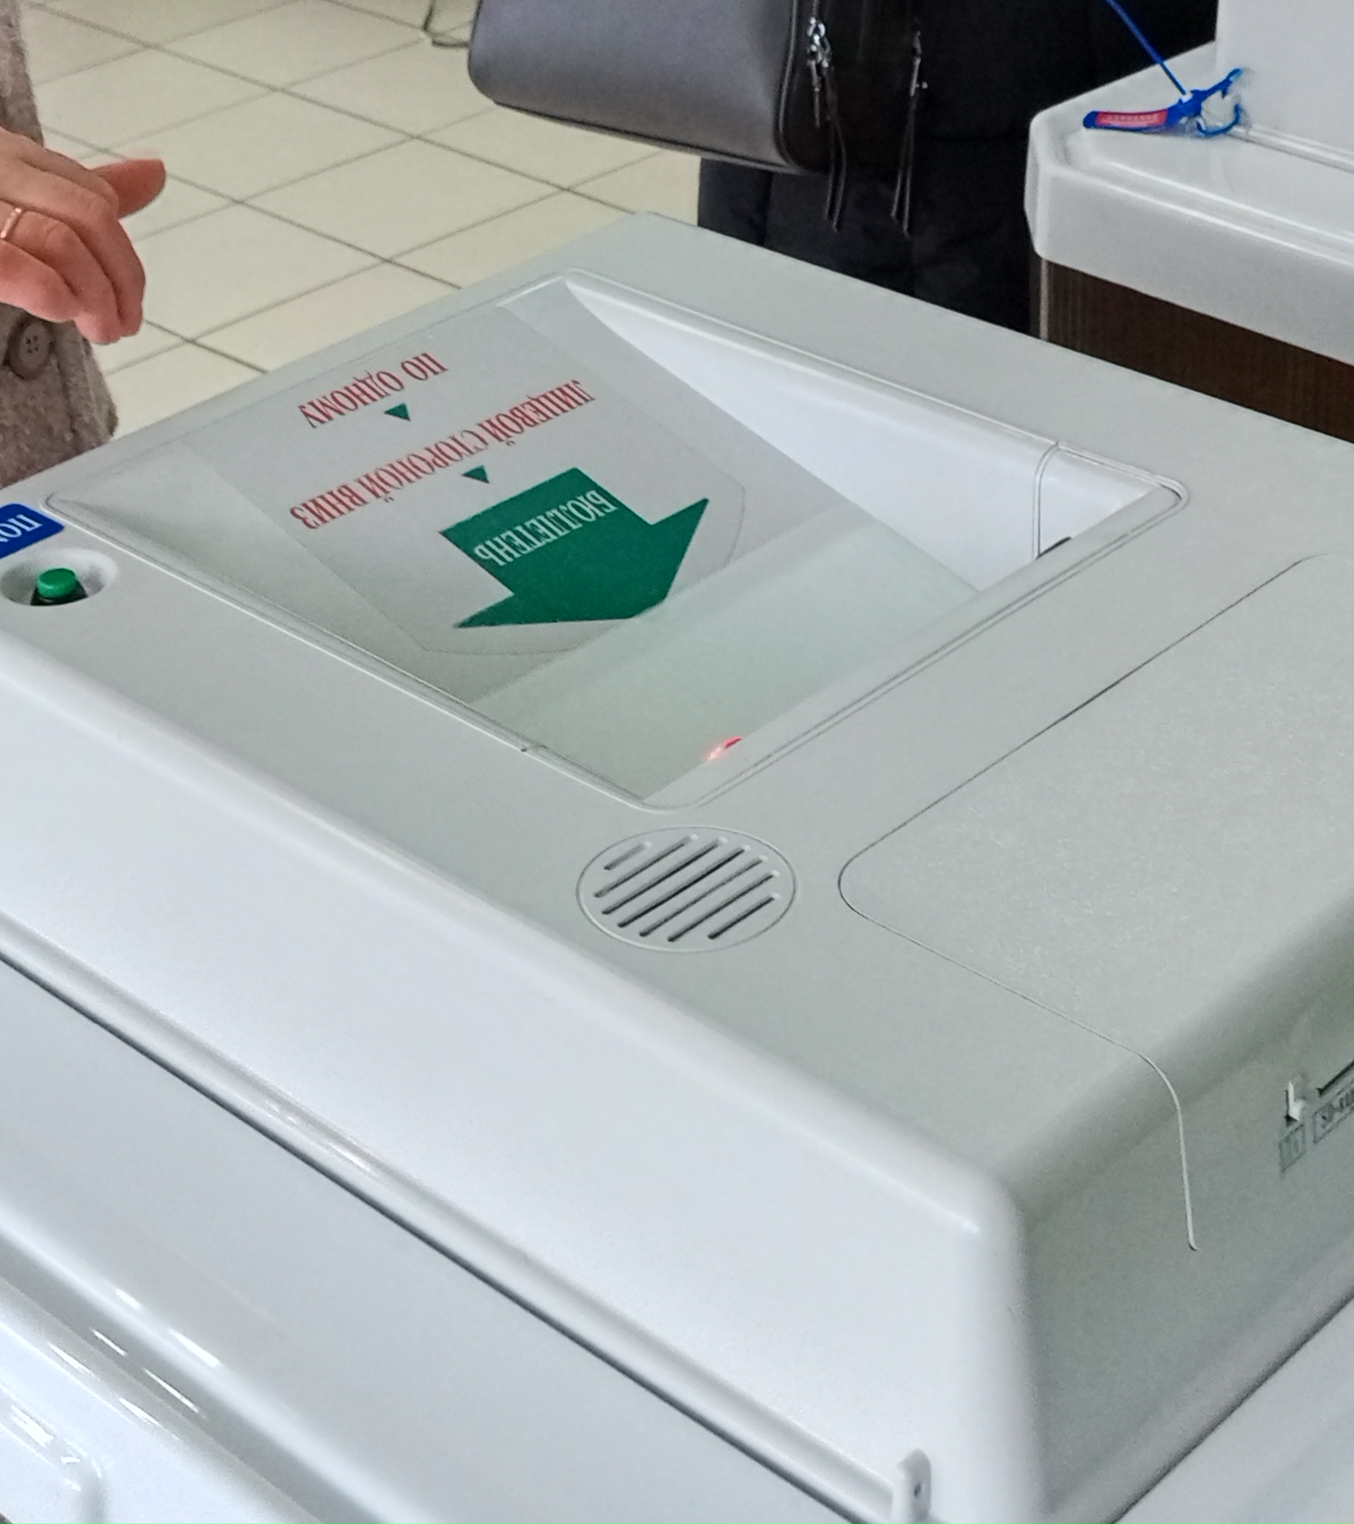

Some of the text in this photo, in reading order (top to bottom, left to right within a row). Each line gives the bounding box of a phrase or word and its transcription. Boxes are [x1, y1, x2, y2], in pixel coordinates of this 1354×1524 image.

[297, 352, 448, 429] ПО ОДНОМУ
[289, 379, 596, 530] ЛИЦЕВОЙ СТОРОНОЙ ВНИЗ
[474, 489, 619, 567] БЮЛЛЕТЕНЬ
